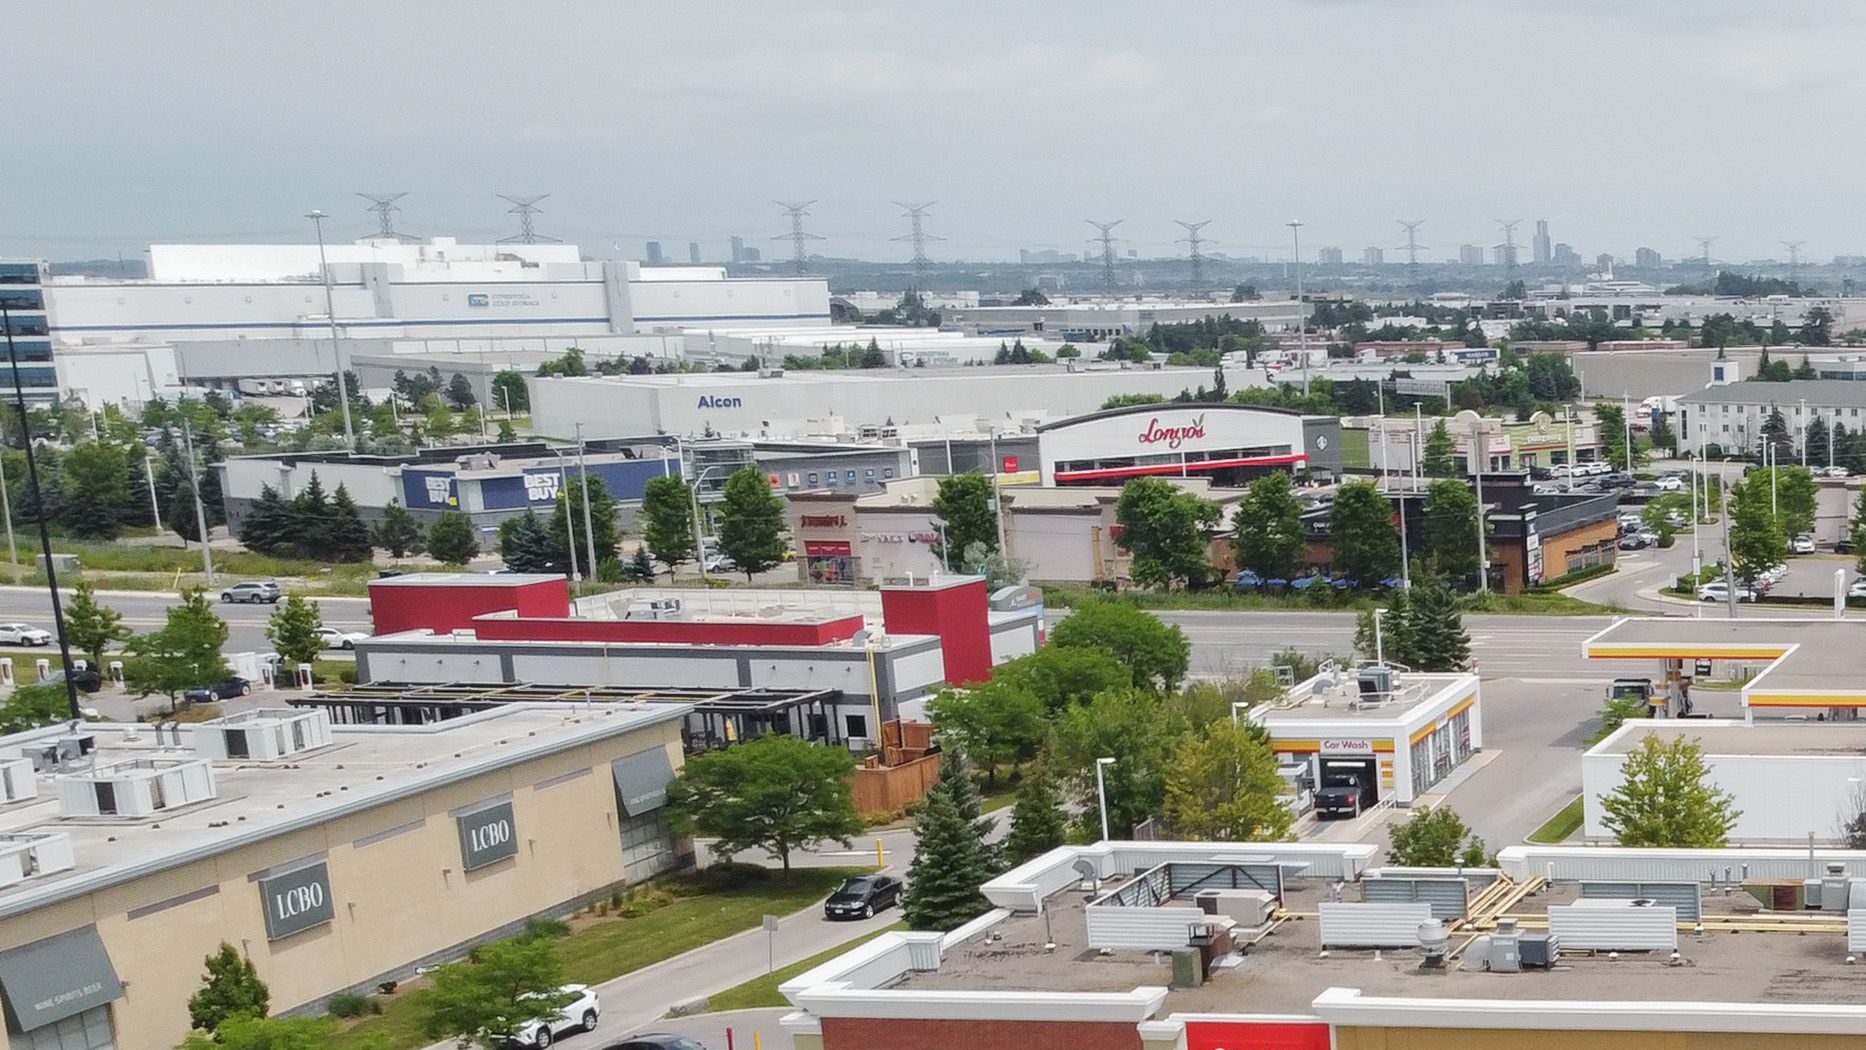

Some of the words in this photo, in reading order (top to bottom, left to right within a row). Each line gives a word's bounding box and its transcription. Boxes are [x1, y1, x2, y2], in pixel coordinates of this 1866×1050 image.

[698, 395, 742, 409] Alcon
[425, 476, 451, 489] BEST
[524, 473, 560, 488] BEST
[429, 489, 451, 503] BUY
[527, 486, 558, 500] BUY
[1324, 740, 1340, 749] Car
[1342, 740, 1368, 749] Wash
[471, 819, 510, 852] LCBO
[276, 882, 323, 919] LCBO
